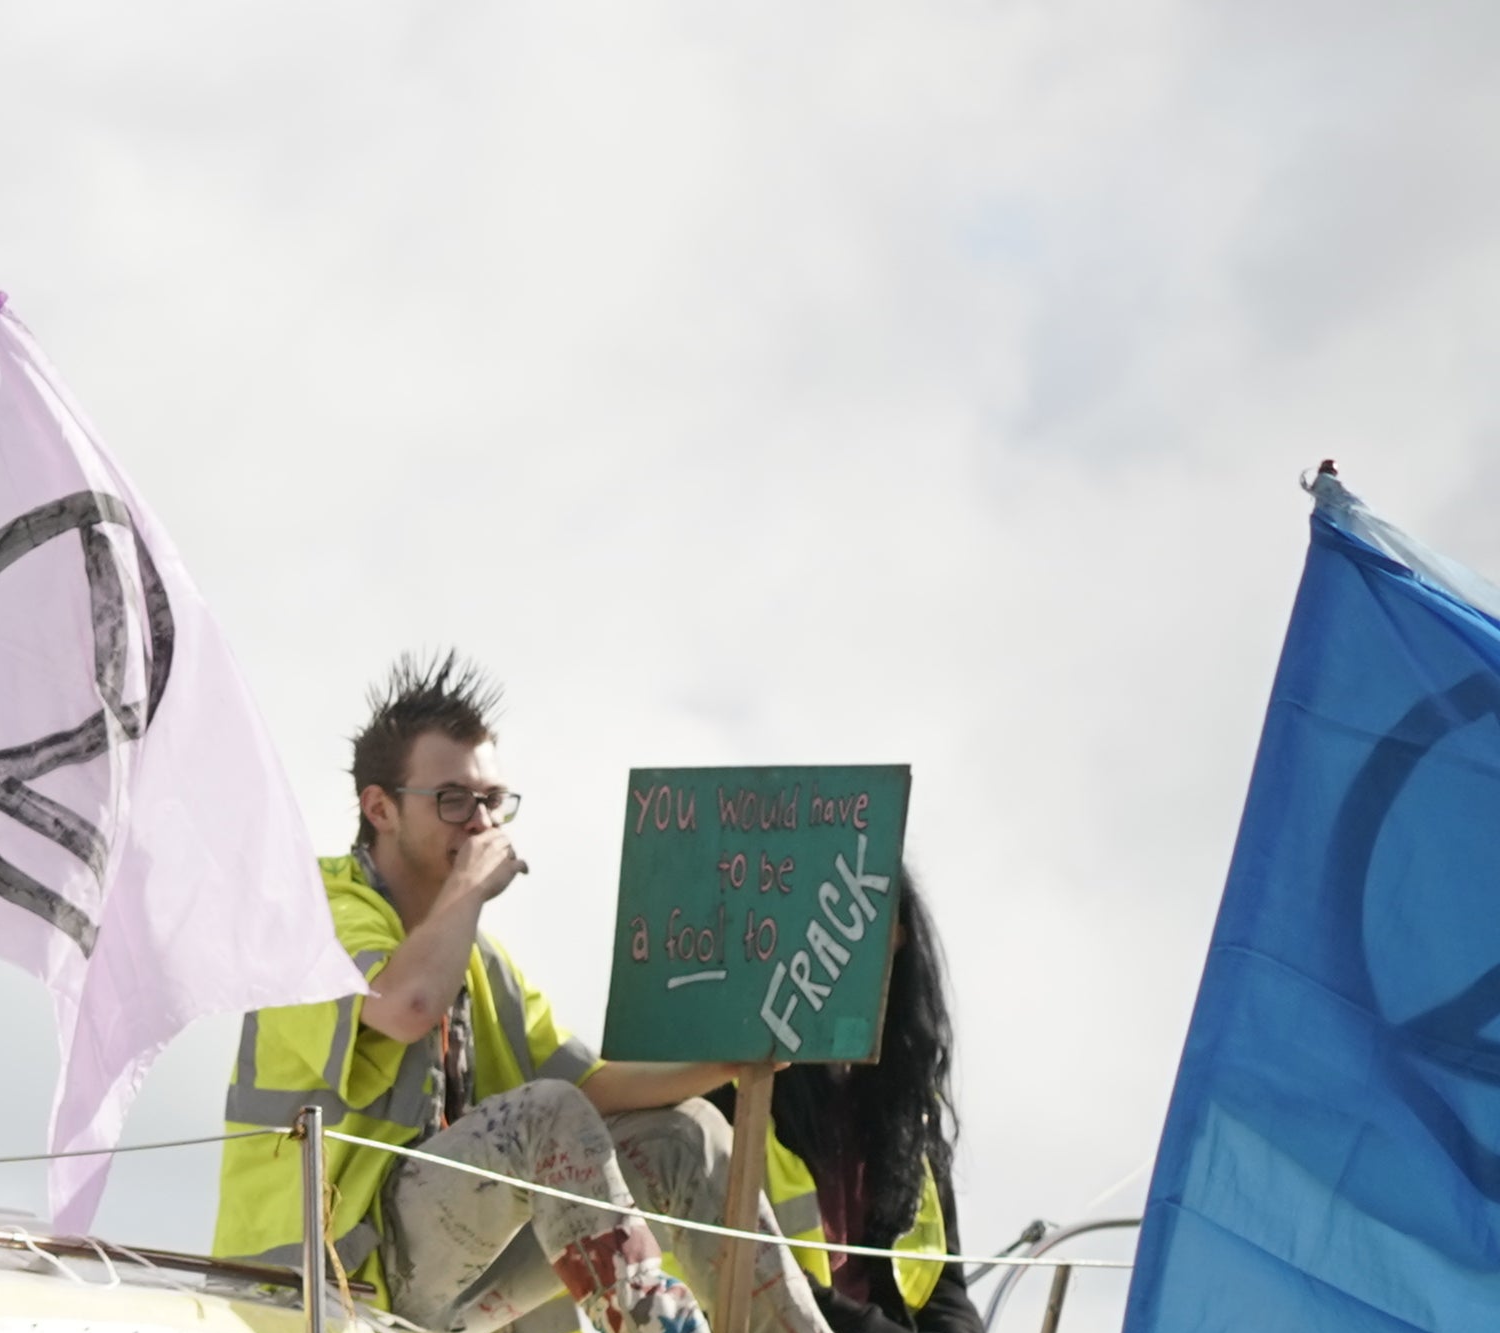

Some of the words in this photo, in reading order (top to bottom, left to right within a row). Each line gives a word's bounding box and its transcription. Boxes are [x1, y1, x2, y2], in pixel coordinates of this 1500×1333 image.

[810, 781, 870, 830] have
[717, 850, 747, 893] to
[760, 852, 795, 893] be
[630, 914, 649, 962] a
[665, 905, 726, 964] fool
[745, 909, 778, 962] to
[760, 833, 891, 1053] FRACK
